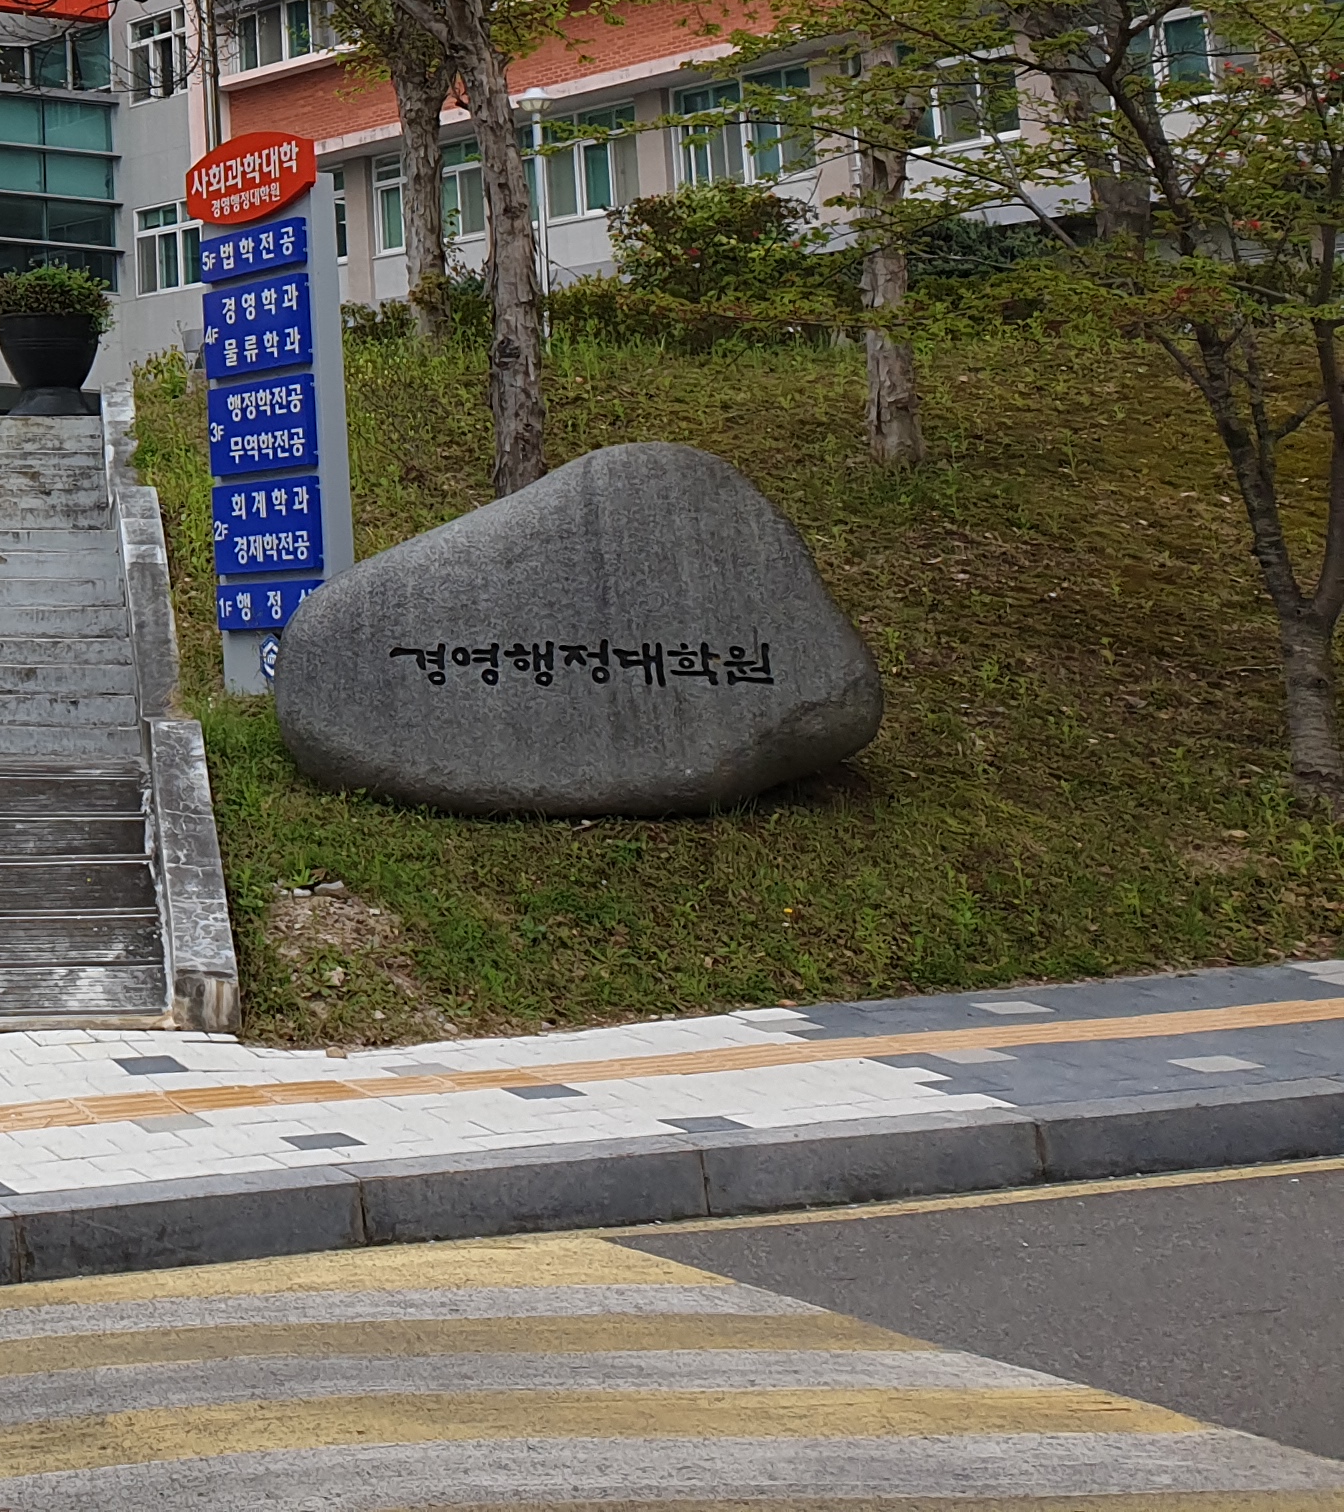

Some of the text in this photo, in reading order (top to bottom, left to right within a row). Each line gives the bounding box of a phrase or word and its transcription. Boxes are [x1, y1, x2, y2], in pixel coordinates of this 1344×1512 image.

[191, 140, 299, 199] 사회과학대학
[211, 182, 281, 218] 경영행정대학원
[202, 226, 296, 272] 5F 법학전공
[221, 283, 299, 325] 경영학과
[204, 325, 219, 346] 4F
[223, 326, 301, 367] 물류학과
[227, 383, 303, 422] 행정학전공
[210, 422, 224, 443] 3F
[229, 427, 305, 464] 무역학전공
[231, 486, 309, 520] 회계학과
[214, 520, 229, 541] 2F
[233, 530, 310, 565] 경제학전공
[218, 597, 233, 618] 1F
[389, 639, 775, 687] 경영행정대학원
